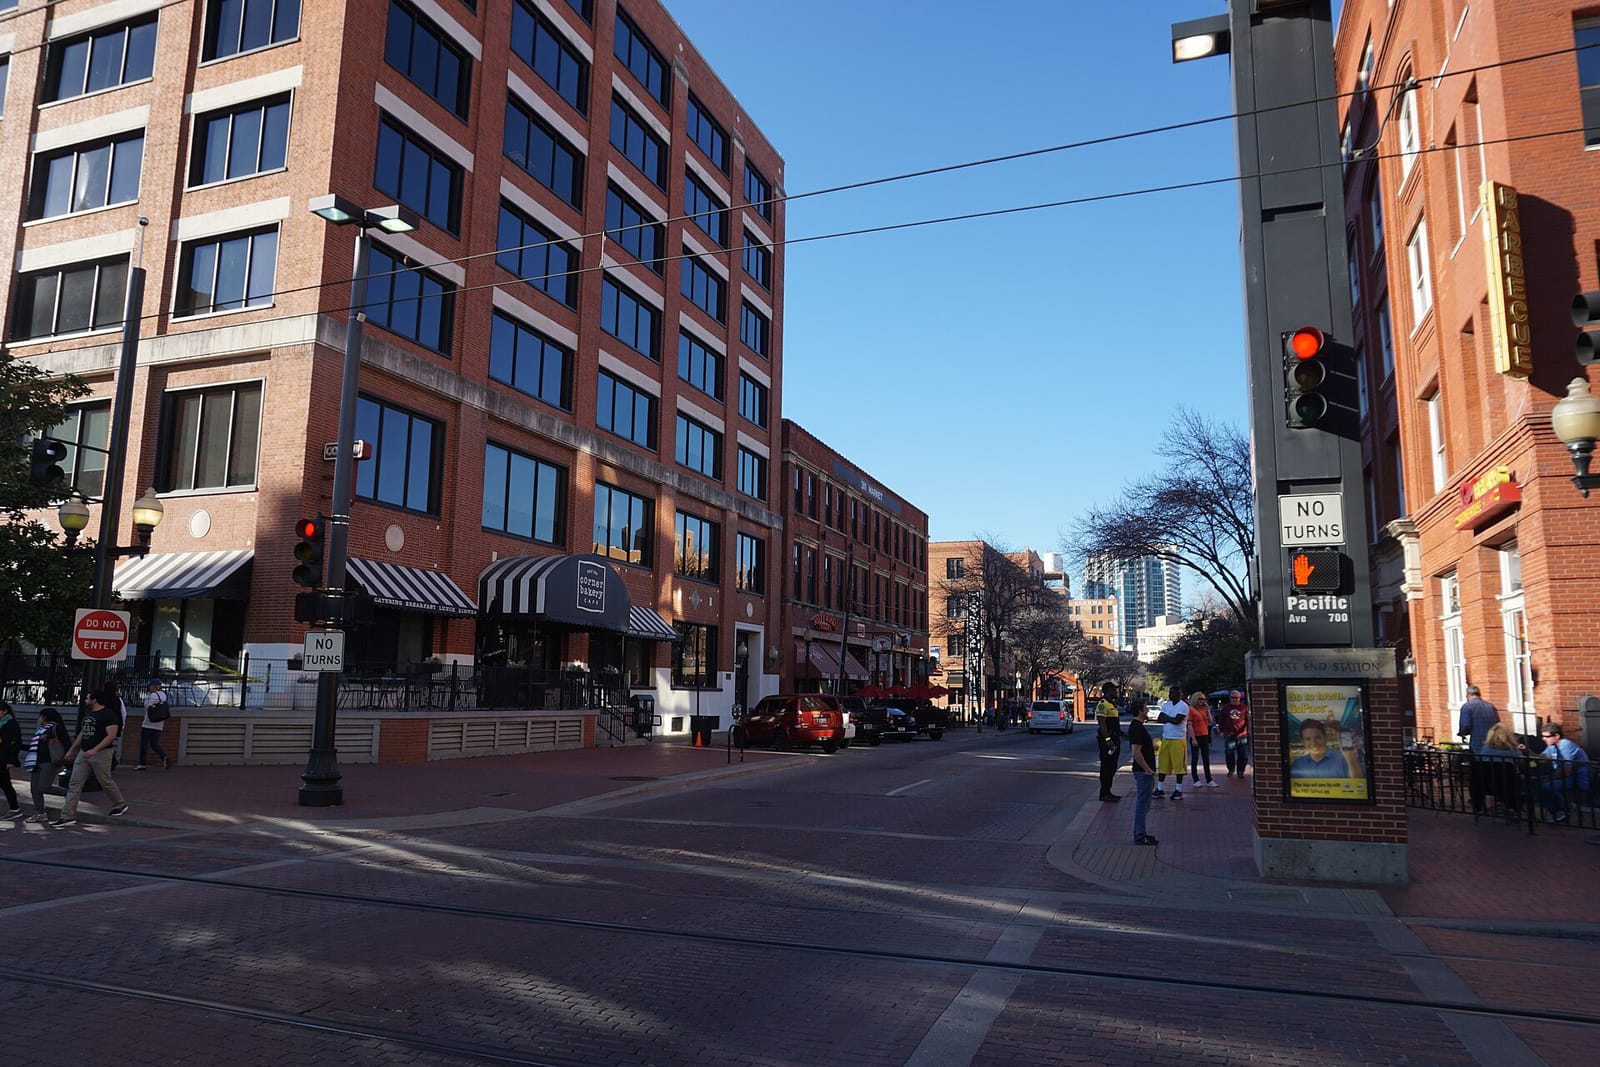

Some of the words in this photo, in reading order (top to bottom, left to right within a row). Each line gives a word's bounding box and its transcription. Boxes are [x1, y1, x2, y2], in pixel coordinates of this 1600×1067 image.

[1498, 186, 1533, 370] BARBECUE
[1297, 500, 1325, 517] NO
[1284, 523, 1341, 539] TURNS
[374, 597, 403, 606] CATERING
[405, 601, 436, 610] BREAKFAST
[1287, 595, 1348, 611] Pacific
[86, 619, 99, 628] DO
[102, 620, 121, 629] NOT
[1289, 614, 1307, 623] Ave
[1328, 613, 1349, 623] 700
[84, 641, 117, 650] ENTER
[315, 638, 333, 651] NO
[305, 654, 341, 665] TURNS
[1267, 662, 1298, 673] WEST
[1303, 662, 1327, 673] END
[1330, 662, 1381, 673] STATION
